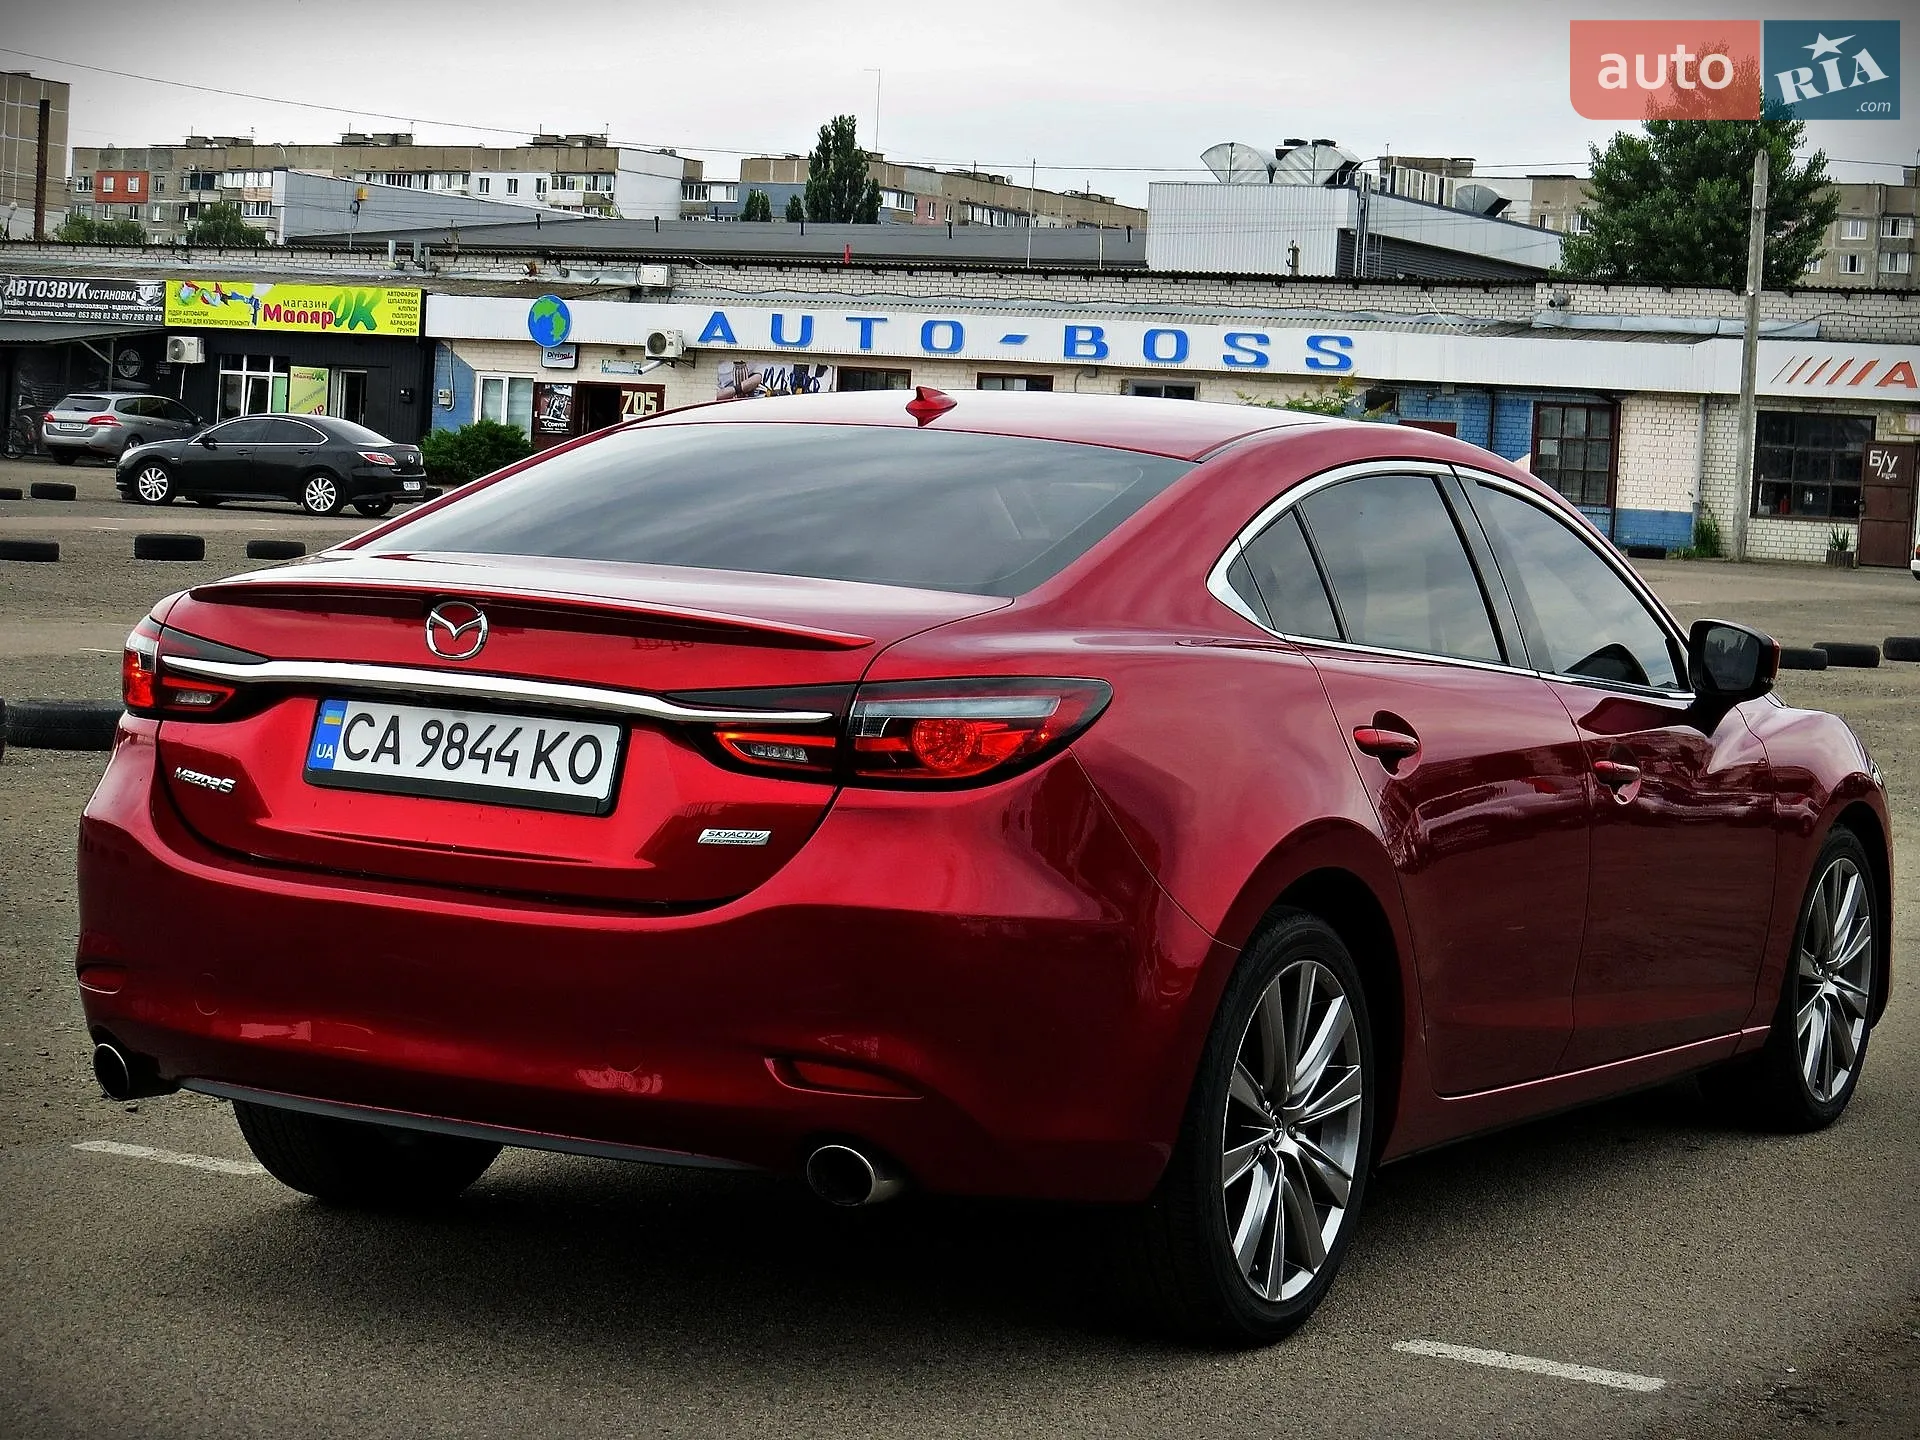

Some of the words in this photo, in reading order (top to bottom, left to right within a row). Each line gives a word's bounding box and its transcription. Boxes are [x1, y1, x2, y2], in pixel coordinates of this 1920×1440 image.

[5, 279, 89, 300] АВТОЗВУК
[89, 289, 137, 301] УСТАНОВКА
[283, 299, 328, 309] магазин
[264, 303, 334, 330] Маляр
[621, 390, 658, 415] 705
[316, 743, 334, 760] UA
[342, 712, 401, 765] CA
[415, 719, 522, 776] 9844
[529, 728, 603, 785] KO
[706, 830, 764, 838] SKYACTIV
